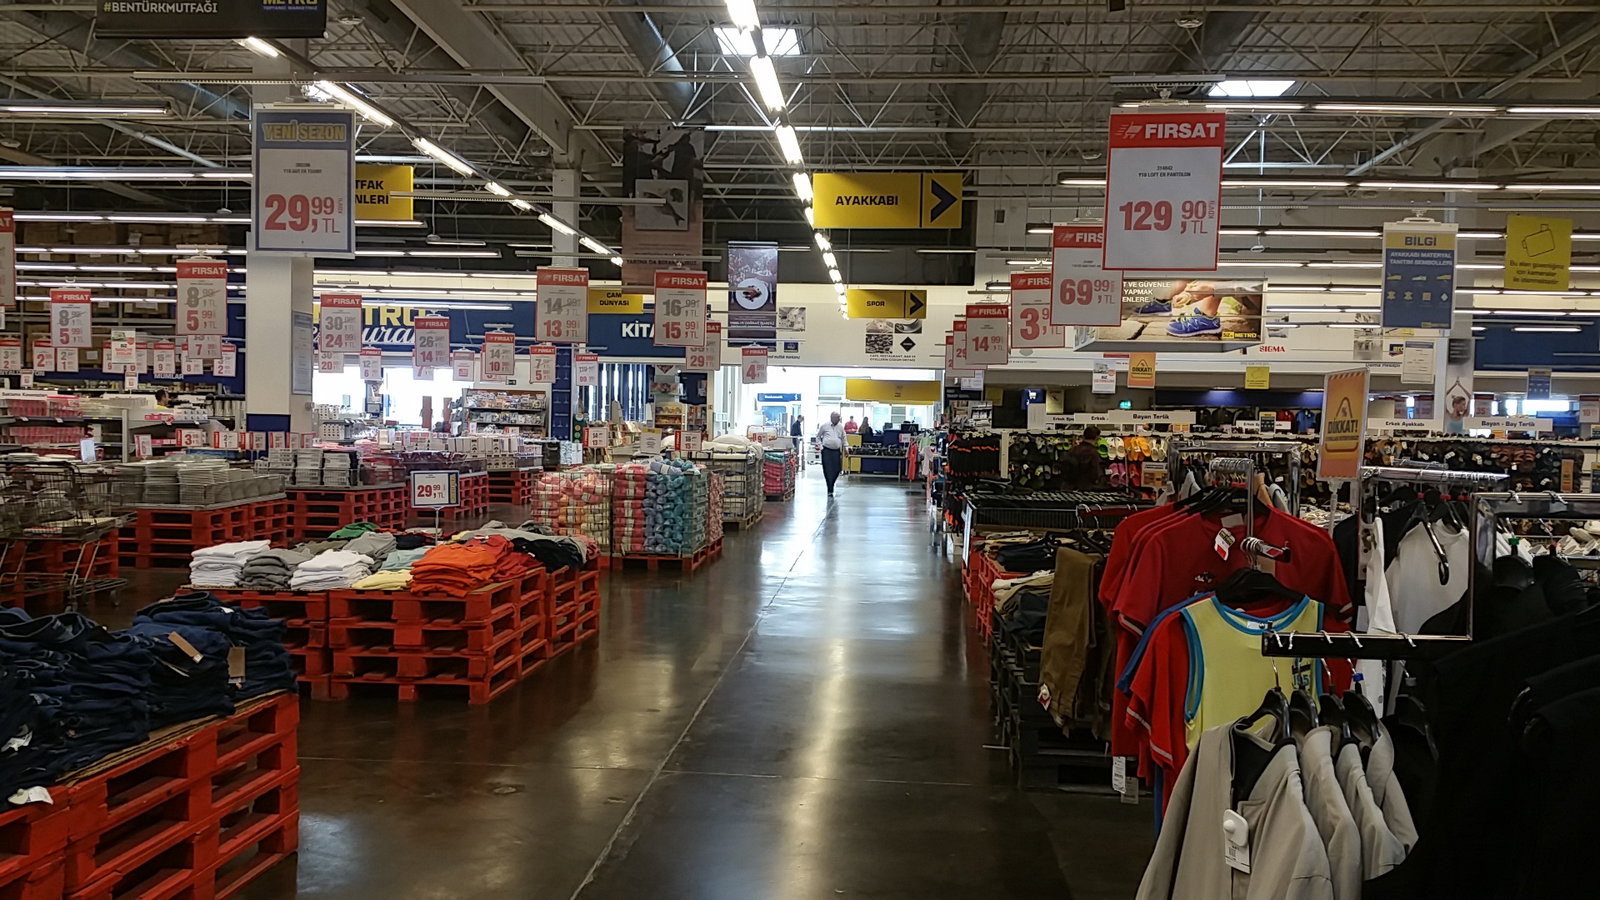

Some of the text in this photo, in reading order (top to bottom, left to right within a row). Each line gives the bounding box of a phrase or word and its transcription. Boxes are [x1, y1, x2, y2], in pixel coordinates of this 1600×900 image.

[104, 0, 218, 13] #BENTÜRKMUTFAĞI
[263, 120, 346, 141] YENİ SEZON
[1145, 123, 1219, 139] FIRSAT
[836, 196, 898, 206] AYAKKABI
[322, 218, 341, 233] TL
[1191, 220, 1208, 234] TL
[192, 267, 225, 275] FIRSAT
[552, 274, 587, 282] FIRSAT
[671, 277, 705, 286] FIRSAT
[1138, 280, 1171, 288] GÜVENLE
[1327, 418, 1358, 434] DİKKAT!
